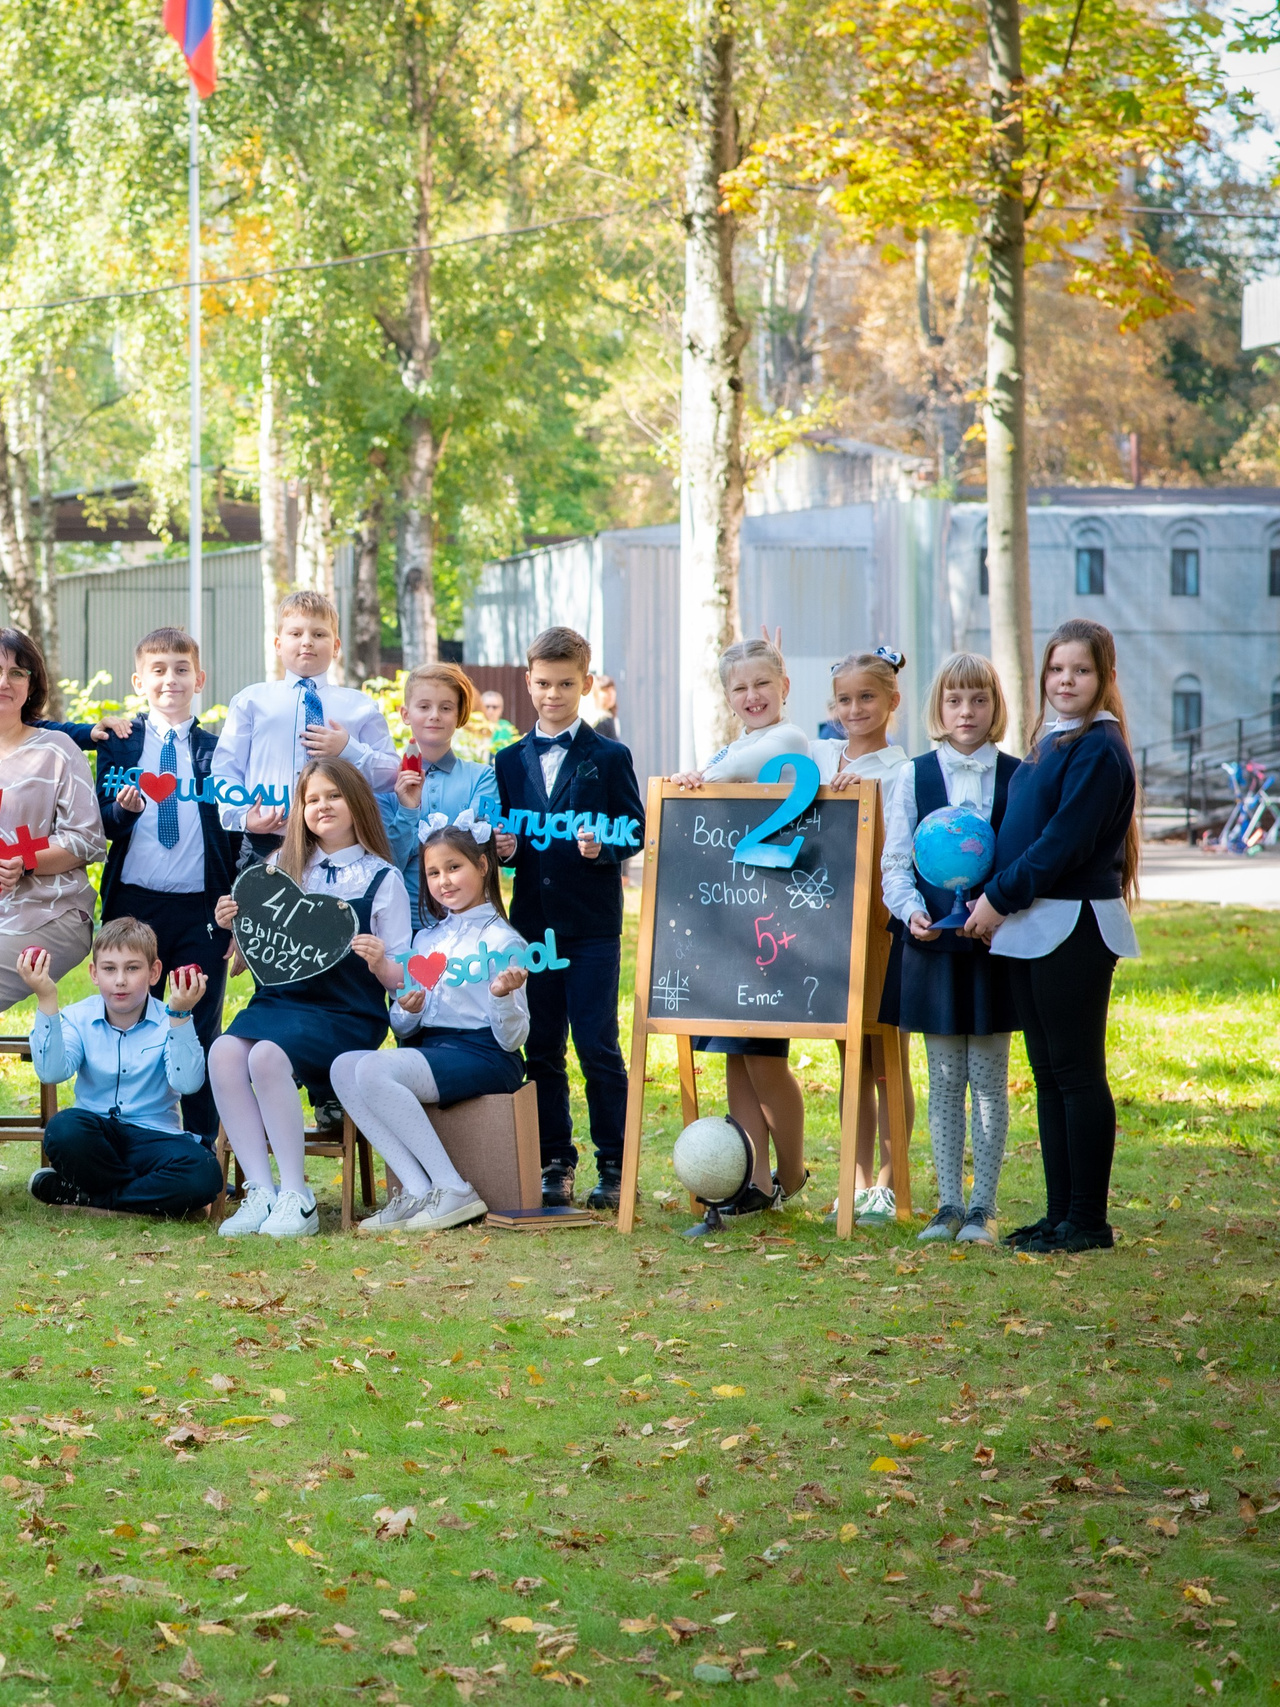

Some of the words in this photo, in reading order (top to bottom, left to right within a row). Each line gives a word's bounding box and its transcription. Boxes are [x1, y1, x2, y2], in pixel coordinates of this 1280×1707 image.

[733, 753, 820, 868] 2
[245, 937, 302, 980] 2024
[754, 911, 797, 967] 5+
